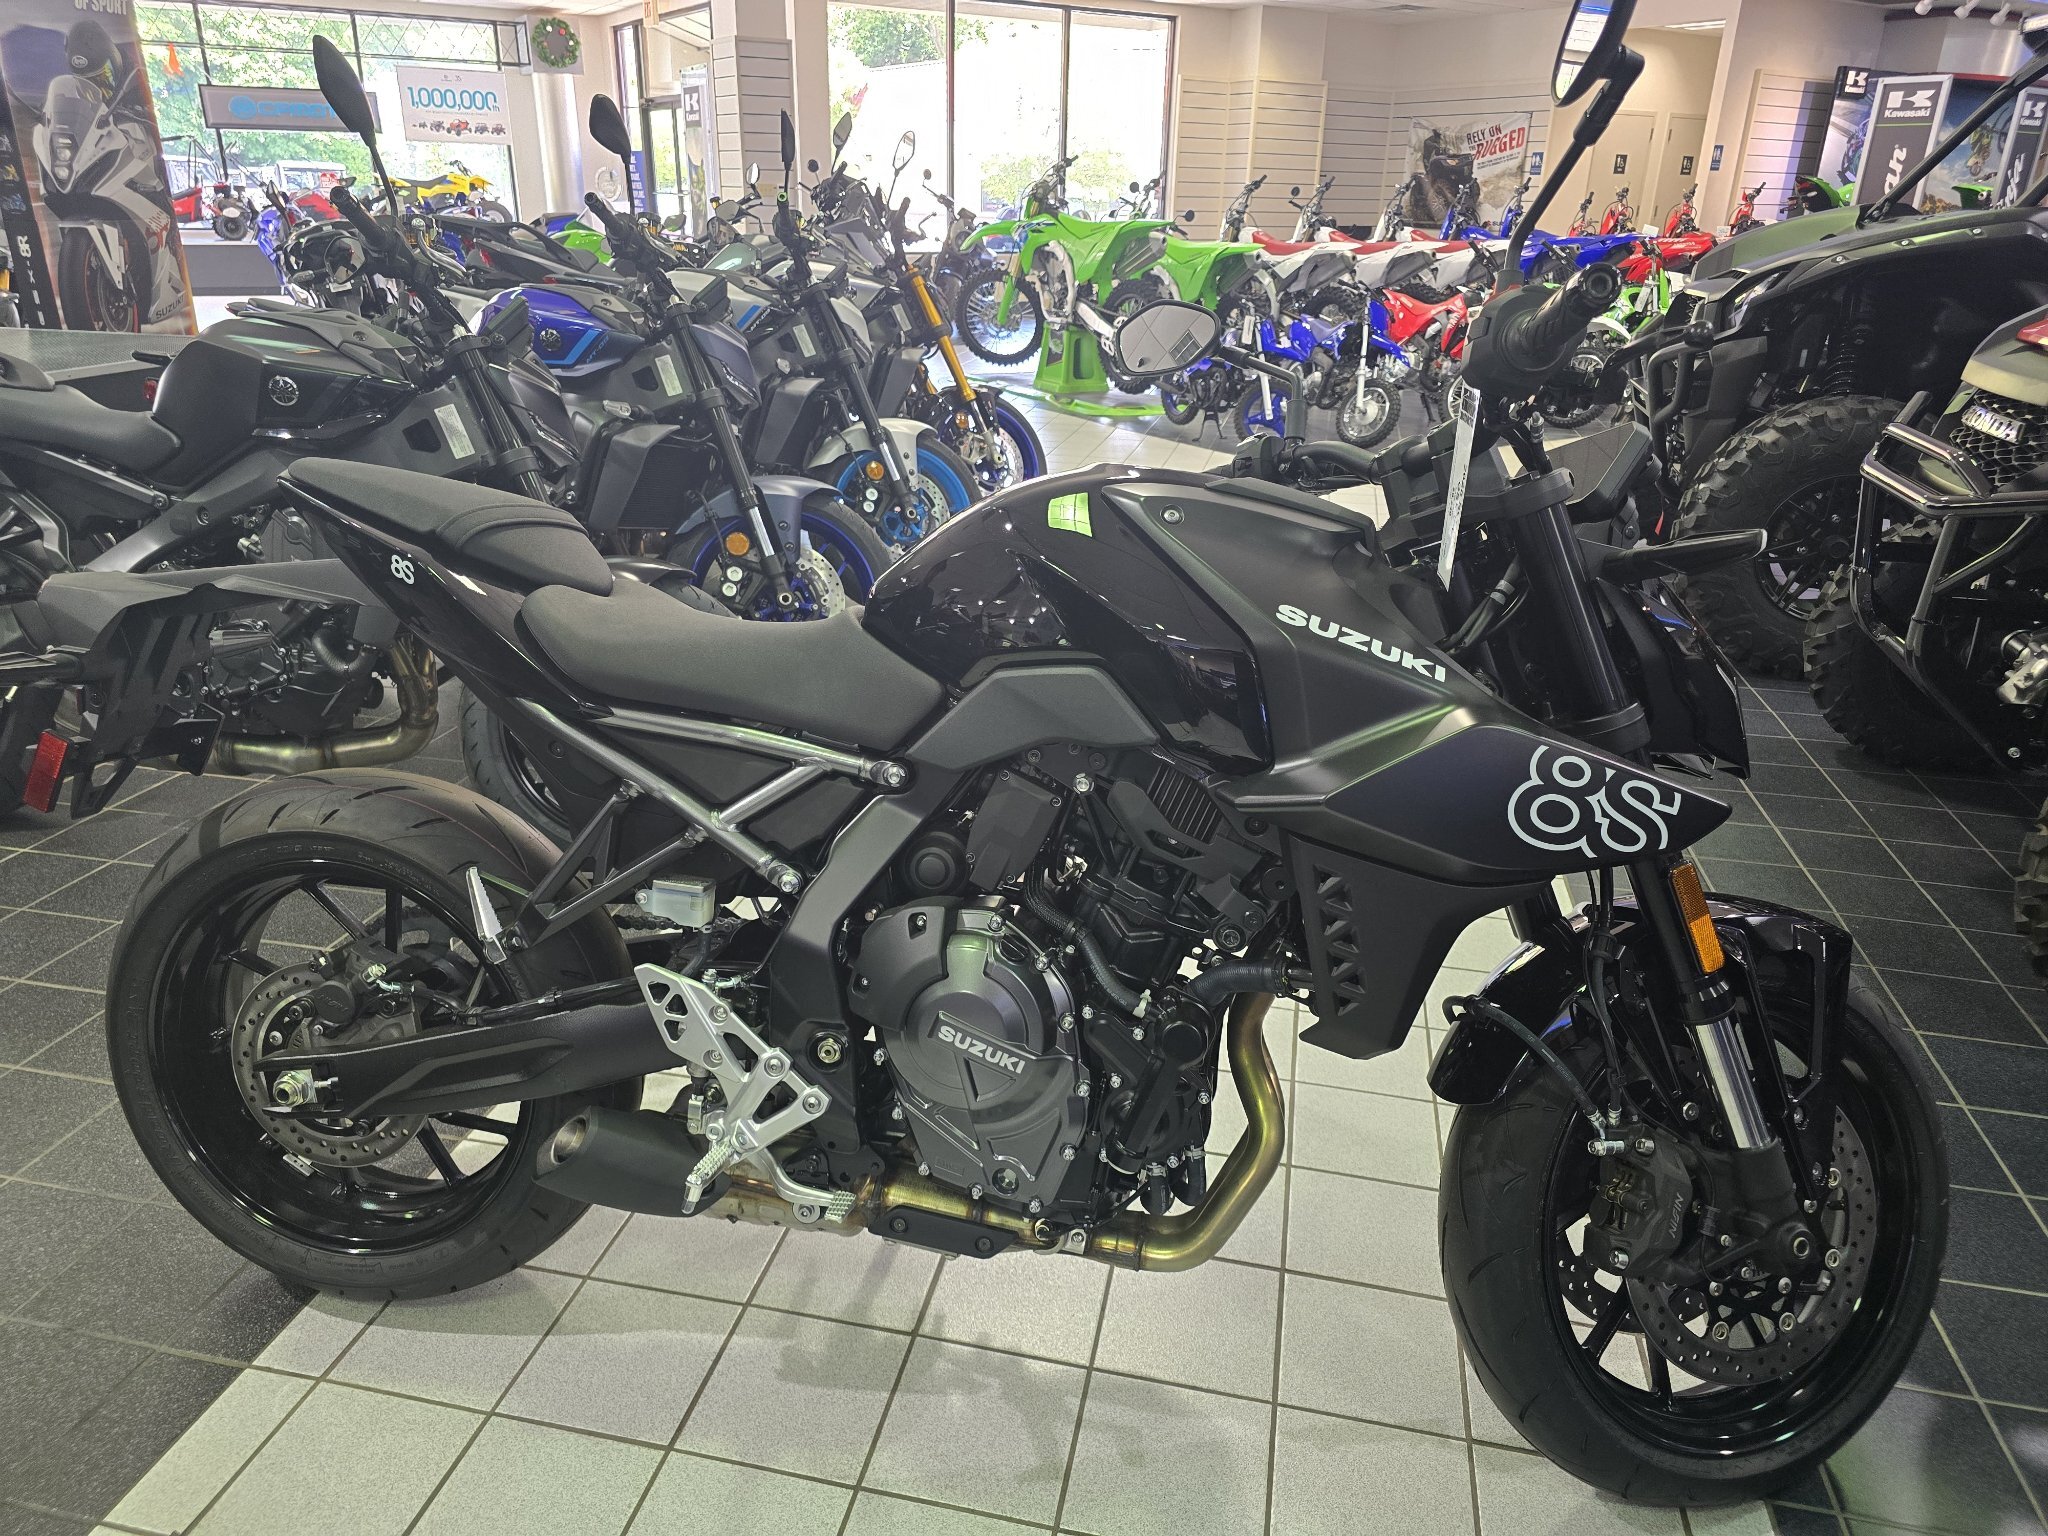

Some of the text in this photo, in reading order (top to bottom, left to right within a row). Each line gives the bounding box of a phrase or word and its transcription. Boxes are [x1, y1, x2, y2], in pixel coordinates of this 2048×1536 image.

[91, 0, 127, 15] SPORT
[1884, 107, 1931, 118] Kawasaki
[1466, 124, 1503, 145] RELY ON
[1474, 127, 1526, 160] RUGGED
[155, 295, 185, 319] SUZUKI
[391, 554, 415, 585] 8S
[1275, 604, 1446, 683] SUZUKI
[938, 1025, 1026, 1074] SUZUKI
